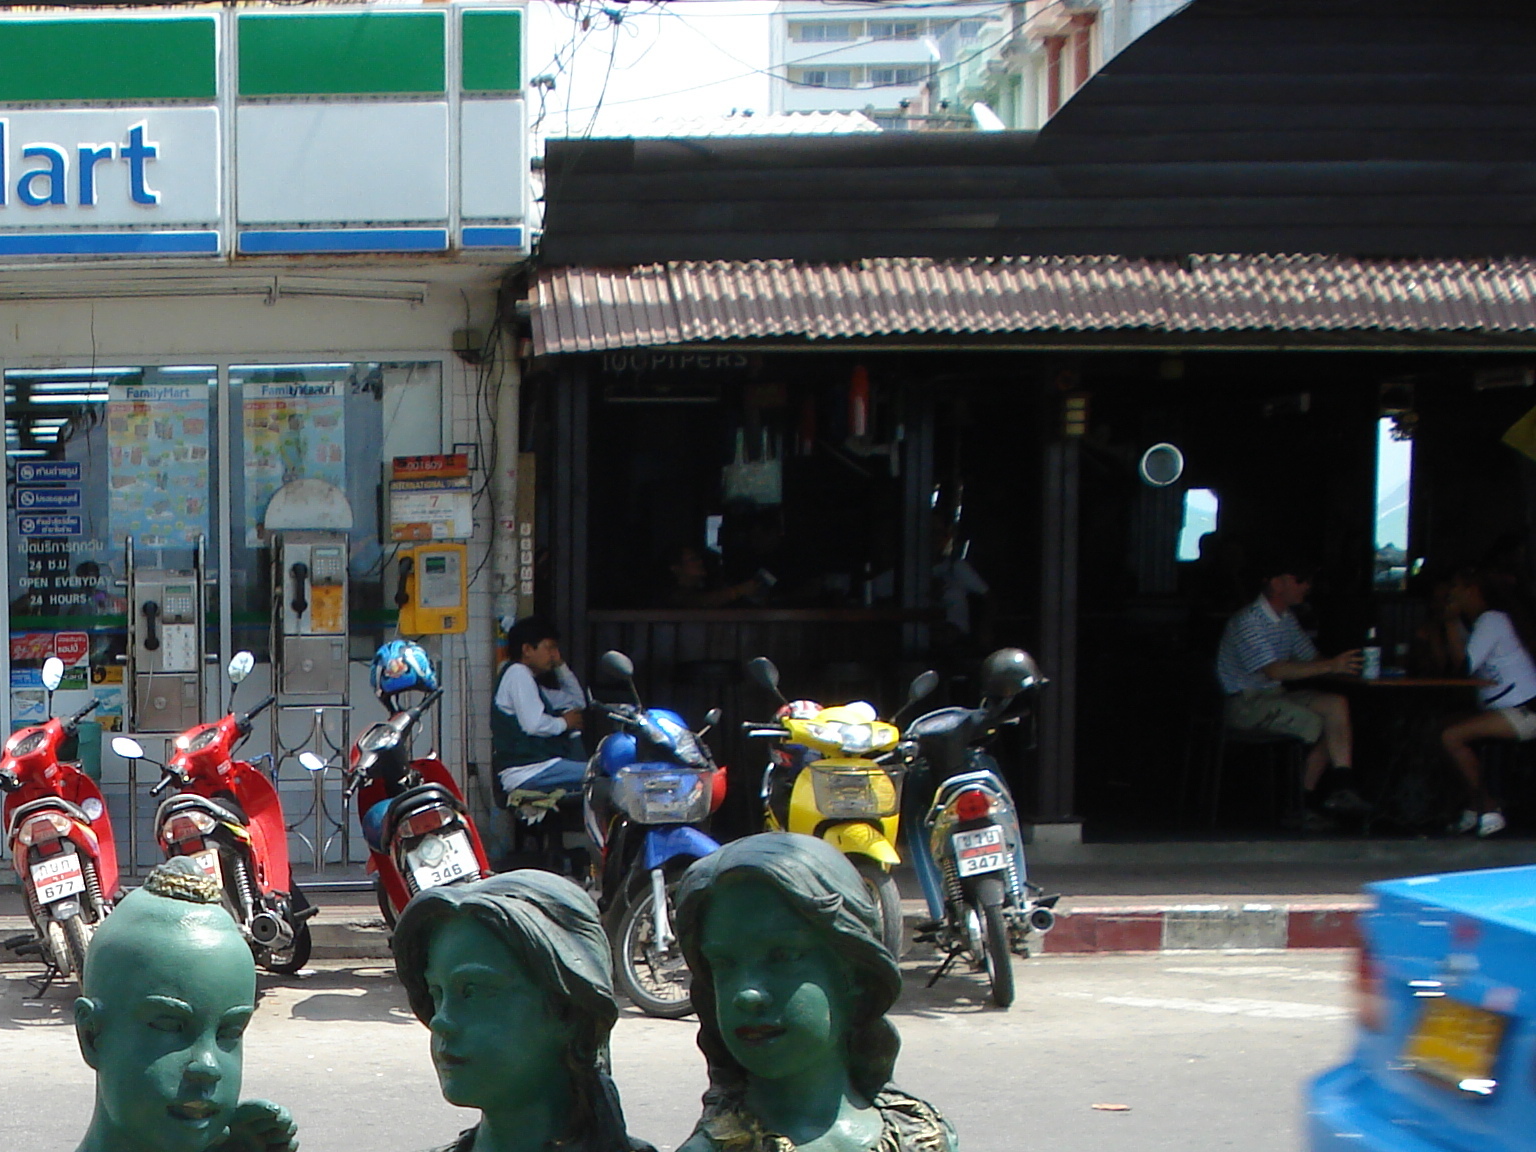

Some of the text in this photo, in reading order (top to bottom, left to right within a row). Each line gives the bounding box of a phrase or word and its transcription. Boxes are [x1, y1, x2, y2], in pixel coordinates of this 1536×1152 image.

[125, 386, 190, 401] FamilyMart
[429, 495, 439, 508] 7
[28, 560, 42, 571] 24
[19, 576, 112, 588] OPEN EVERYDAY
[29, 594, 43, 605] 24
[967, 855, 999, 872] 347
[430, 863, 463, 883] 346
[44, 881, 74, 898] 677
